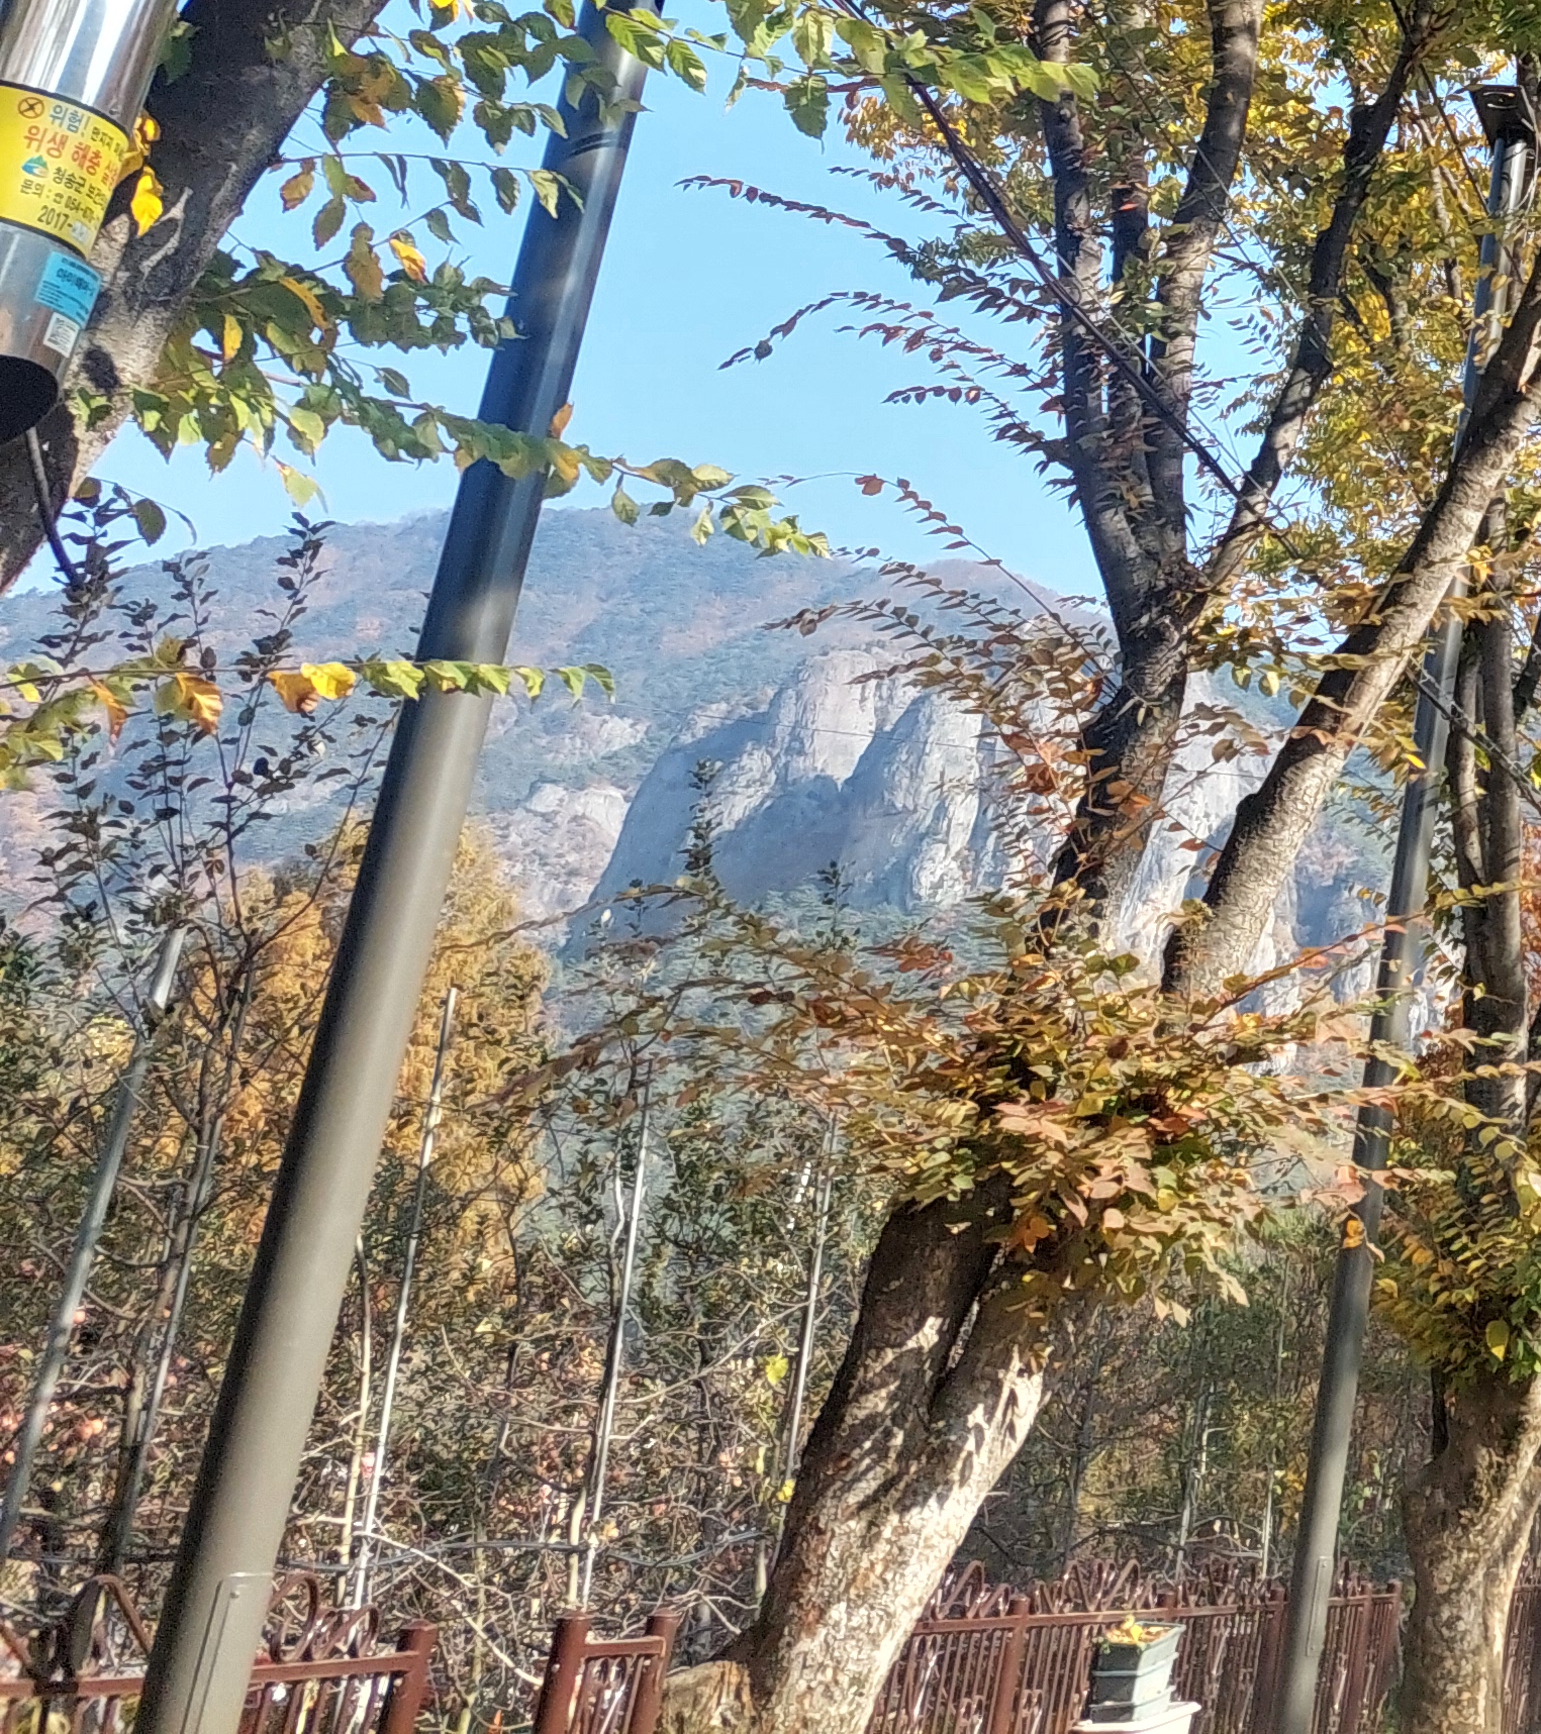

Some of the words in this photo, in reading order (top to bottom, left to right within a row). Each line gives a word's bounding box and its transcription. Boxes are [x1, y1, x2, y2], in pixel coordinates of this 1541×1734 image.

[23, 125, 69, 159] 위생
[71, 142, 103, 177] 해충
[20, 178, 45, 198] 문의
[52, 166, 87, 195] 청송군
